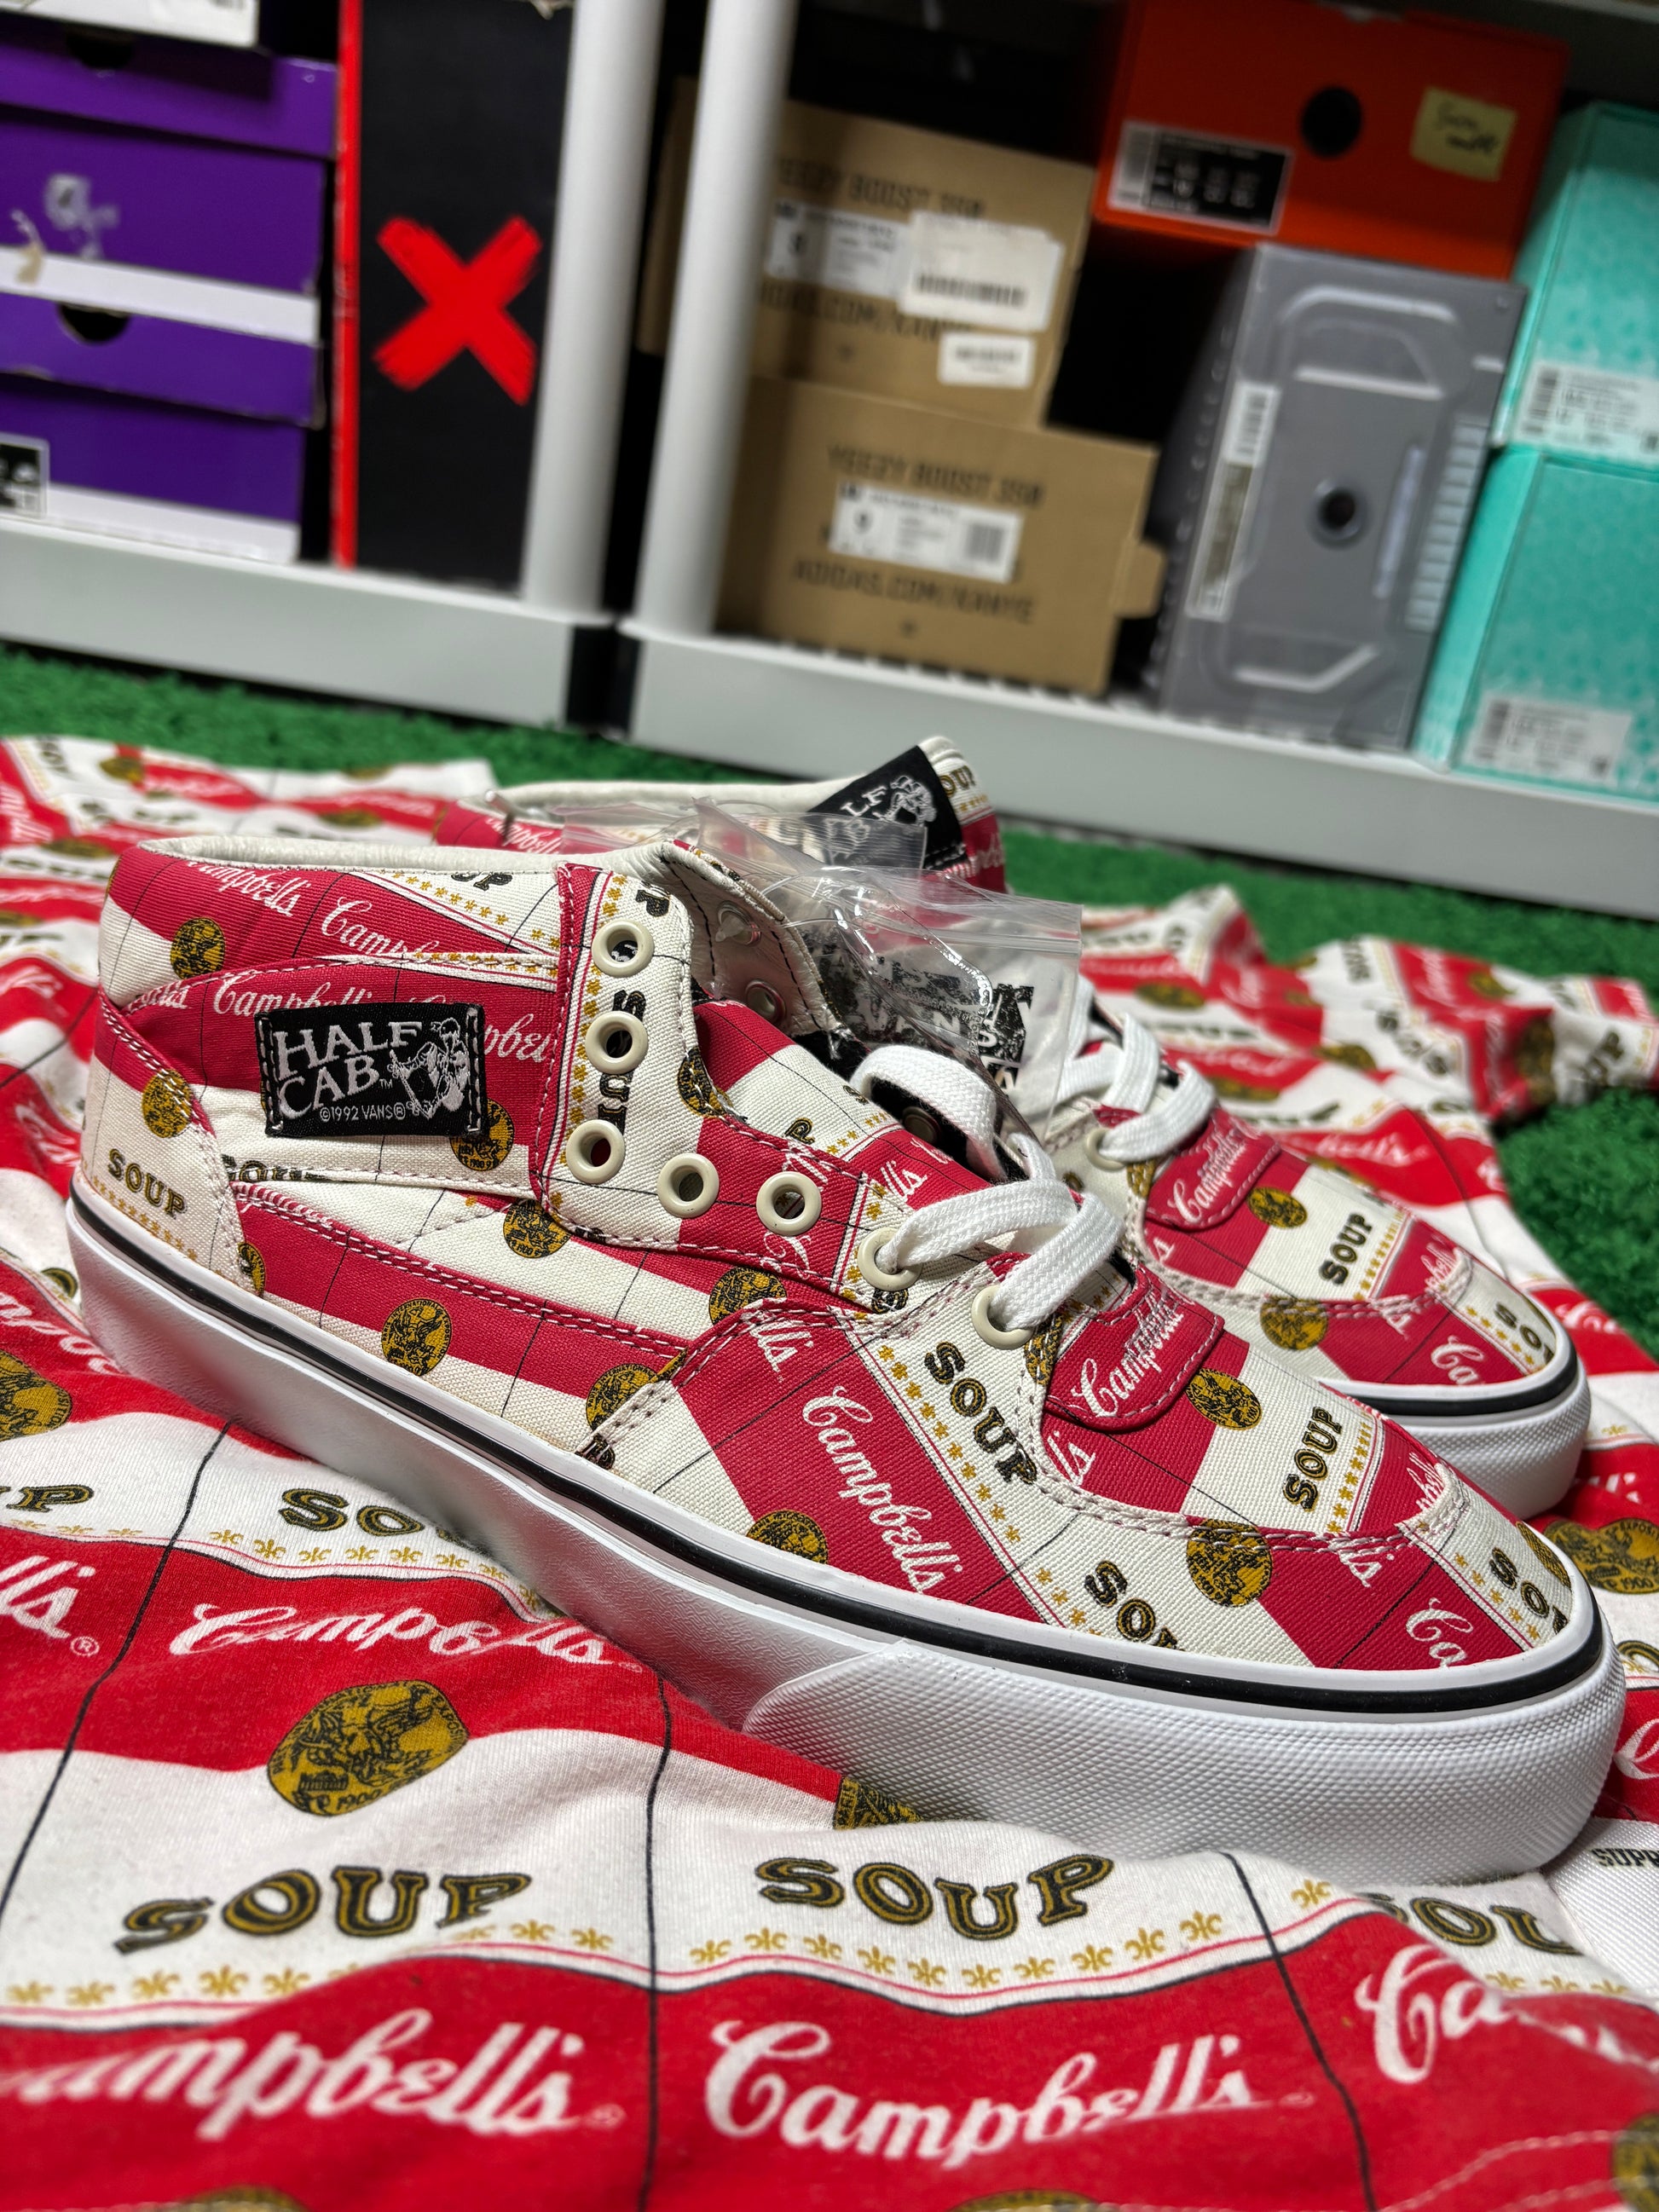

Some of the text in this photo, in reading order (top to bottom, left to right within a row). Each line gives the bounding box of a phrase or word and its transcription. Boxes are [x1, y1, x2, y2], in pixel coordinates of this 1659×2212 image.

[273, 1021, 423, 1081] HALF
[279, 1054, 380, 1119] CAB
[107, 1148, 188, 1219] SOUP
[1318, 1212, 1373, 1285] SOUP
[923, 1341, 1038, 1486] SOUP
[801, 1385, 963, 1594] Campbell's
[1282, 1406, 1343, 1512] SOUP
[169, 1603, 609, 1666] Campbell's
[113, 1865, 534, 1956] SOUP
[754, 1857, 1114, 1941] SOUP
[704, 2019, 1255, 2169] Campbell's
